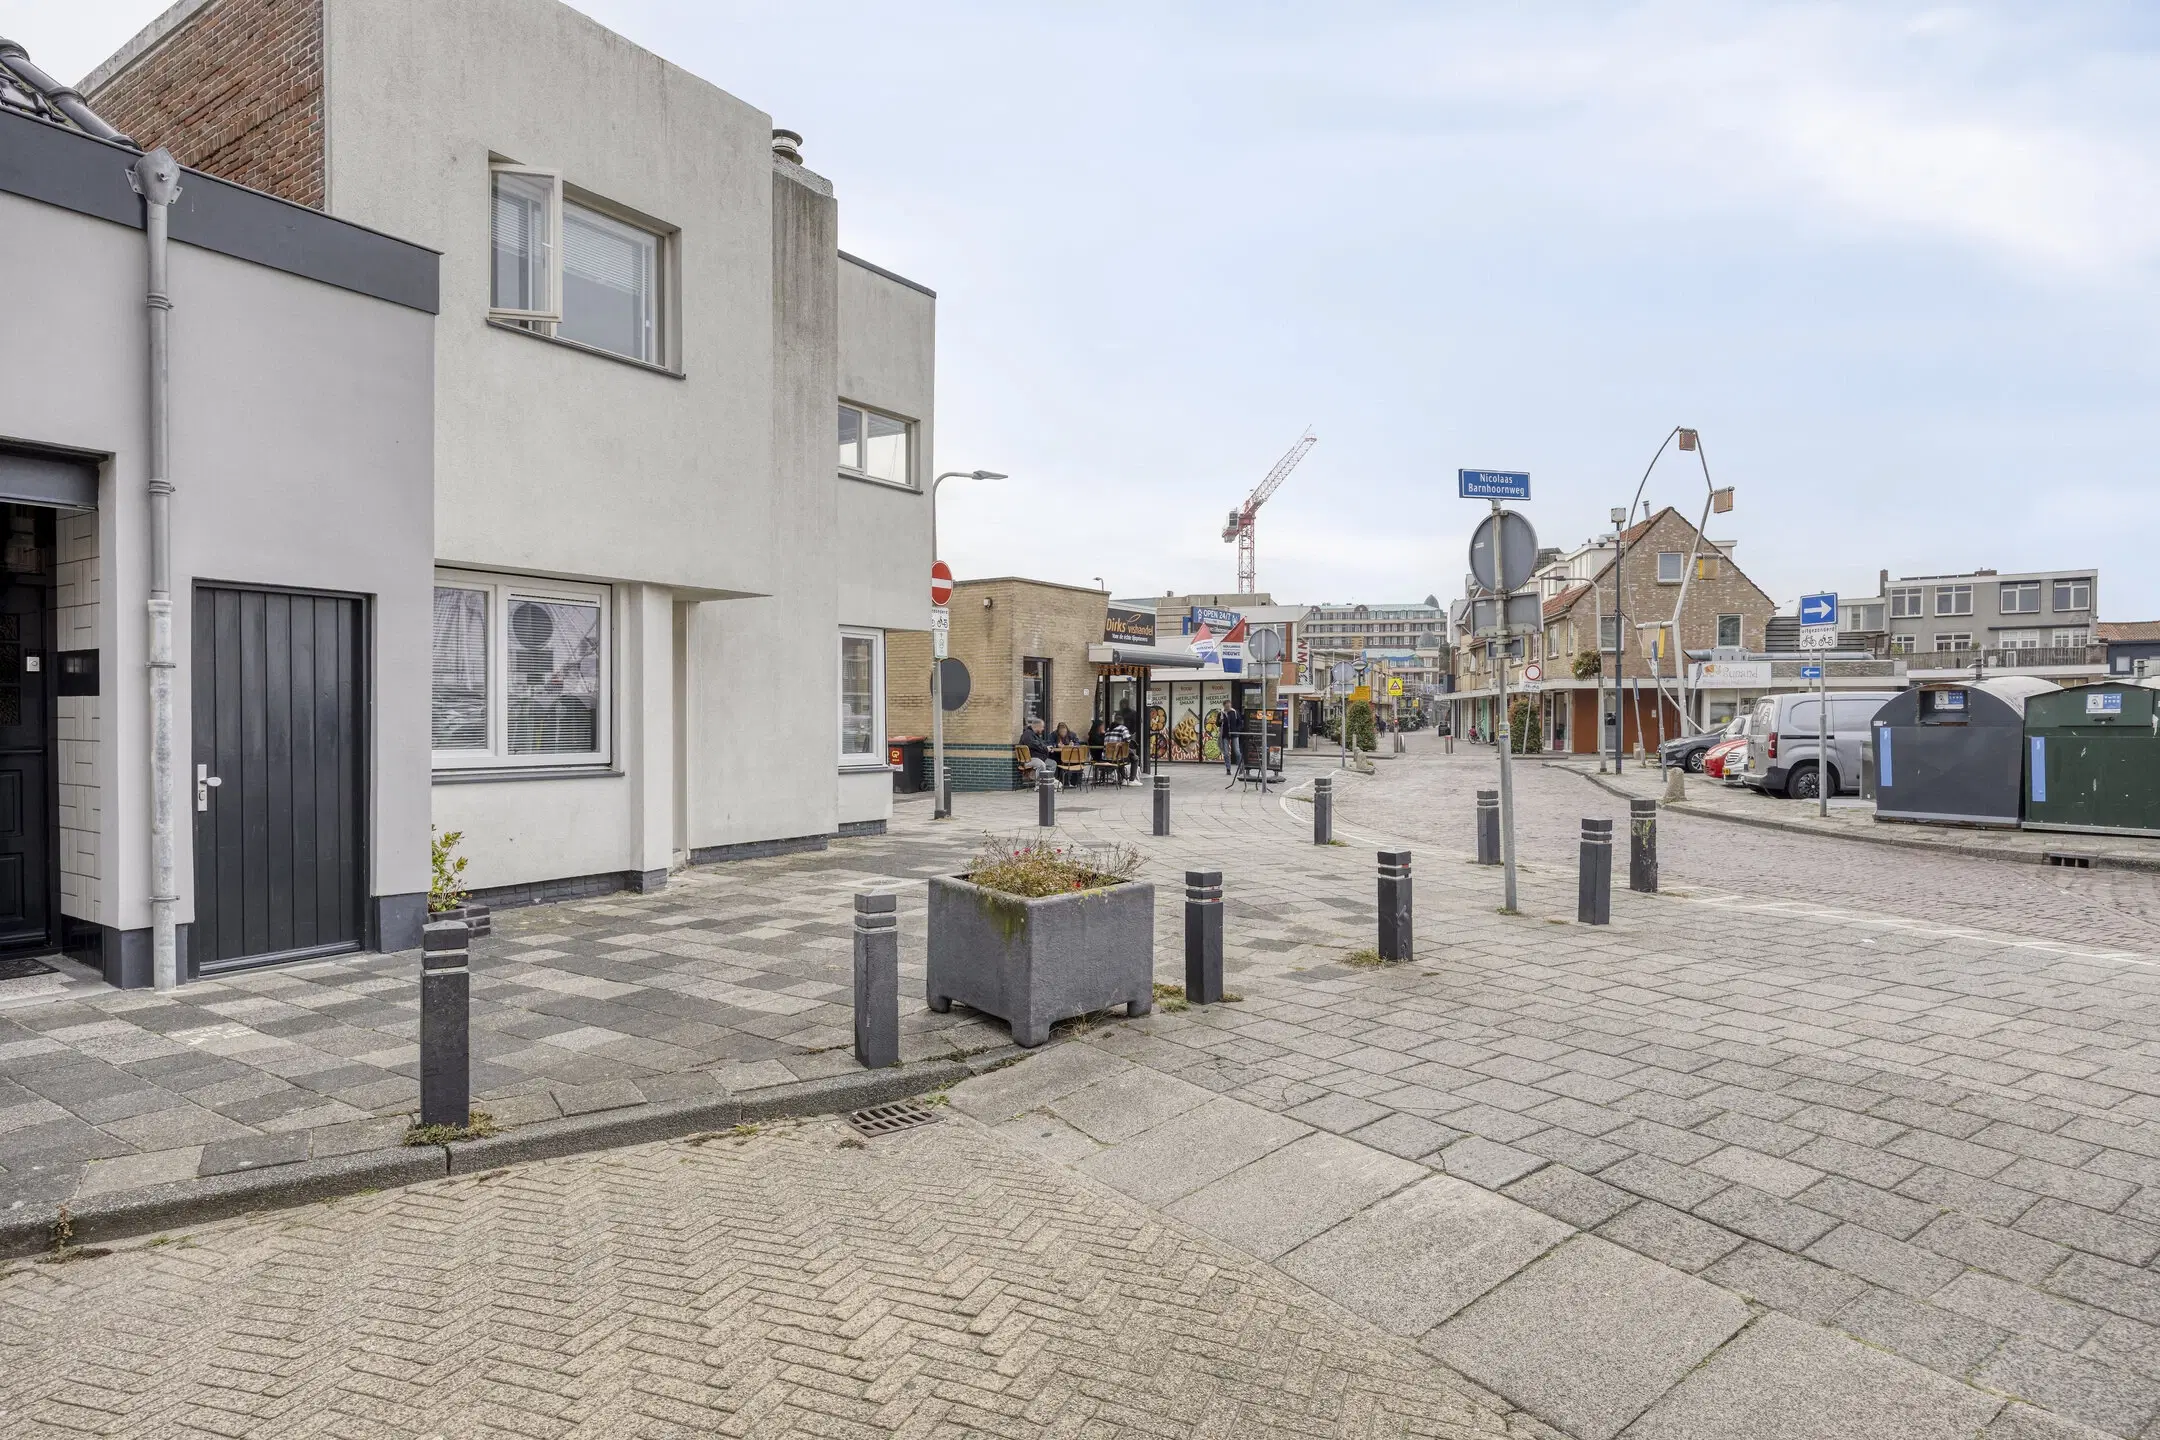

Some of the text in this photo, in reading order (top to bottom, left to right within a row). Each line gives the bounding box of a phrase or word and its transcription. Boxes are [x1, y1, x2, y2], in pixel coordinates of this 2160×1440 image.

[1480, 474, 1513, 483] Nicolaas
[1468, 483, 1525, 496] Barnhoornweg
[1204, 610, 1230, 620] OPEN 24/7
[1106, 618, 1126, 632] Dirks
